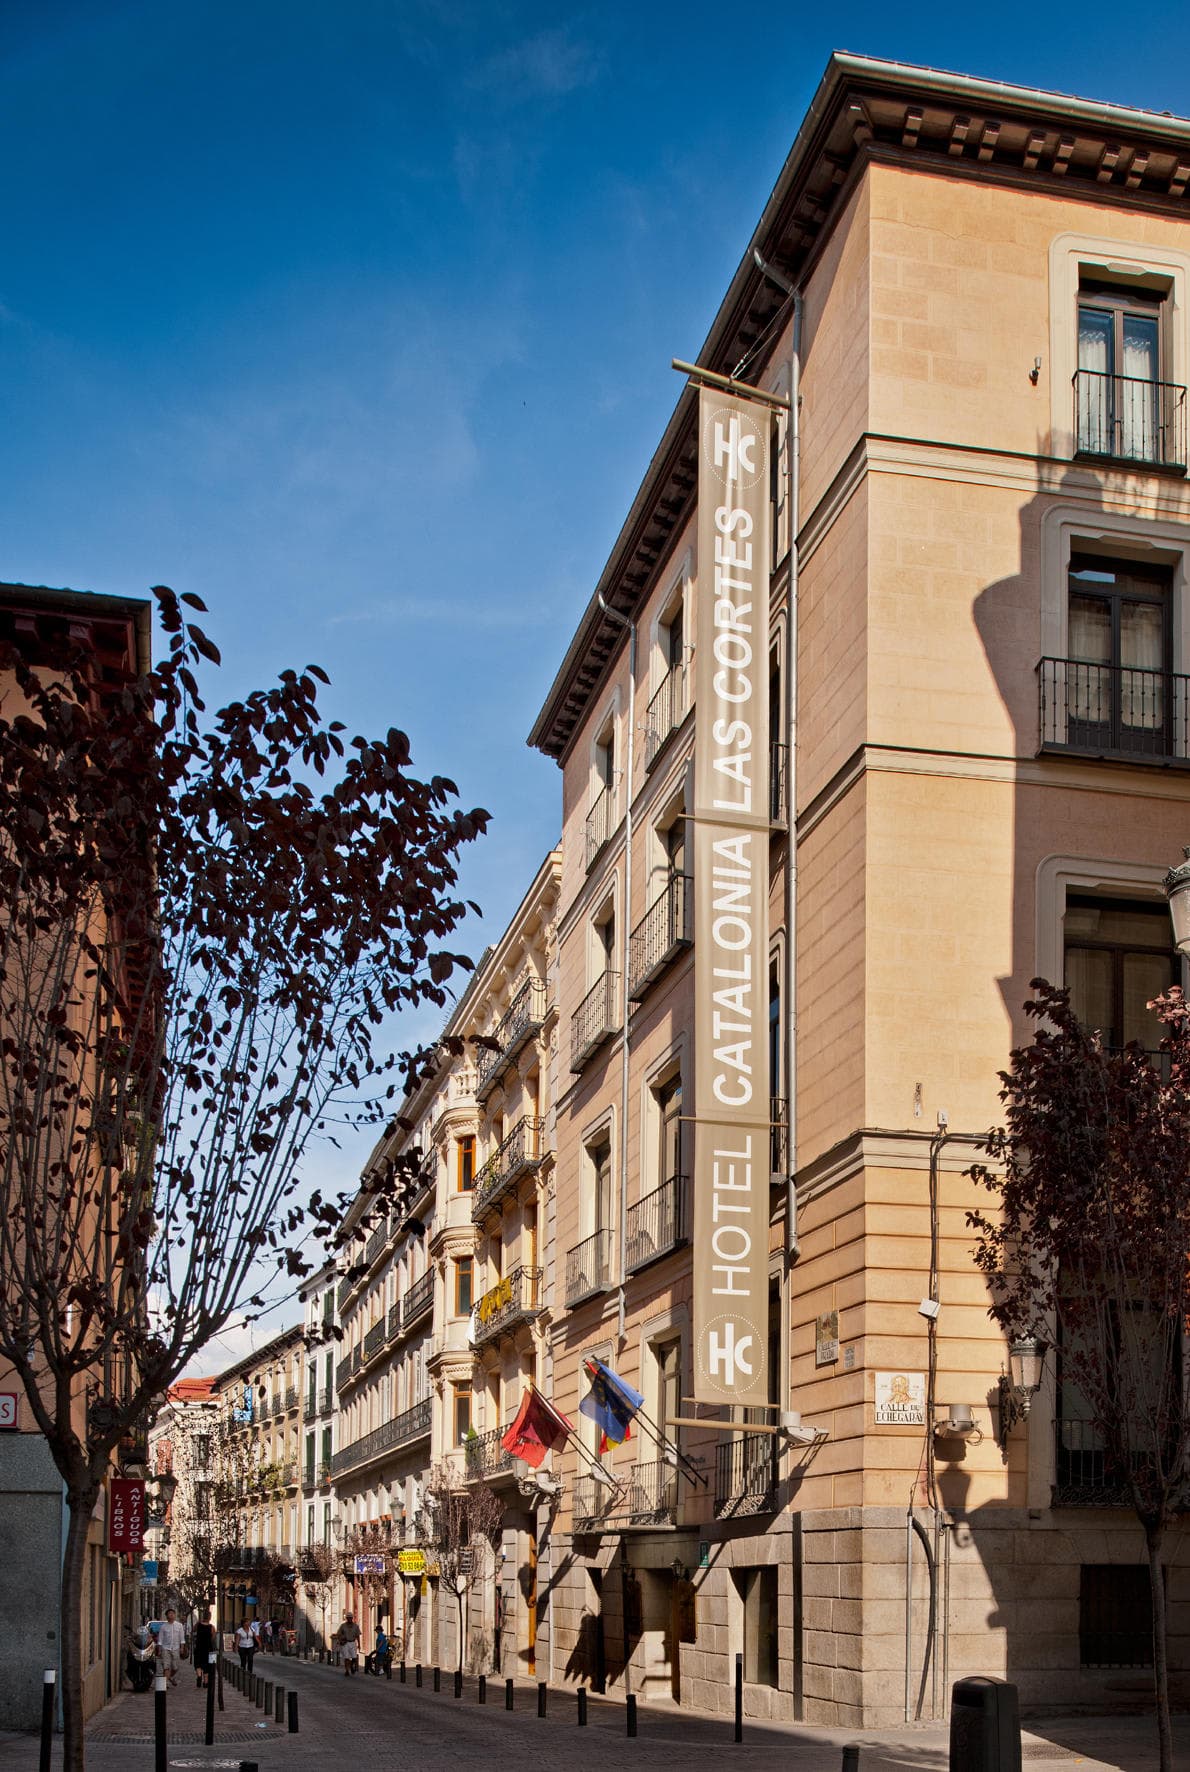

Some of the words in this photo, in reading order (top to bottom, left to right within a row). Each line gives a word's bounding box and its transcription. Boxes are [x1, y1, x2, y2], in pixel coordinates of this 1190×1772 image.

[713, 506, 754, 704] CORTES
[712, 718, 753, 813] LAS
[712, 833, 753, 1106] CATALONIA
[711, 1135, 752, 1296] HOTEL
[876, 1412, 923, 1422] ECHEGARAY
[113, 1494, 124, 1537] LIBROS
[129, 1487, 141, 1544] ANTIGUOS
